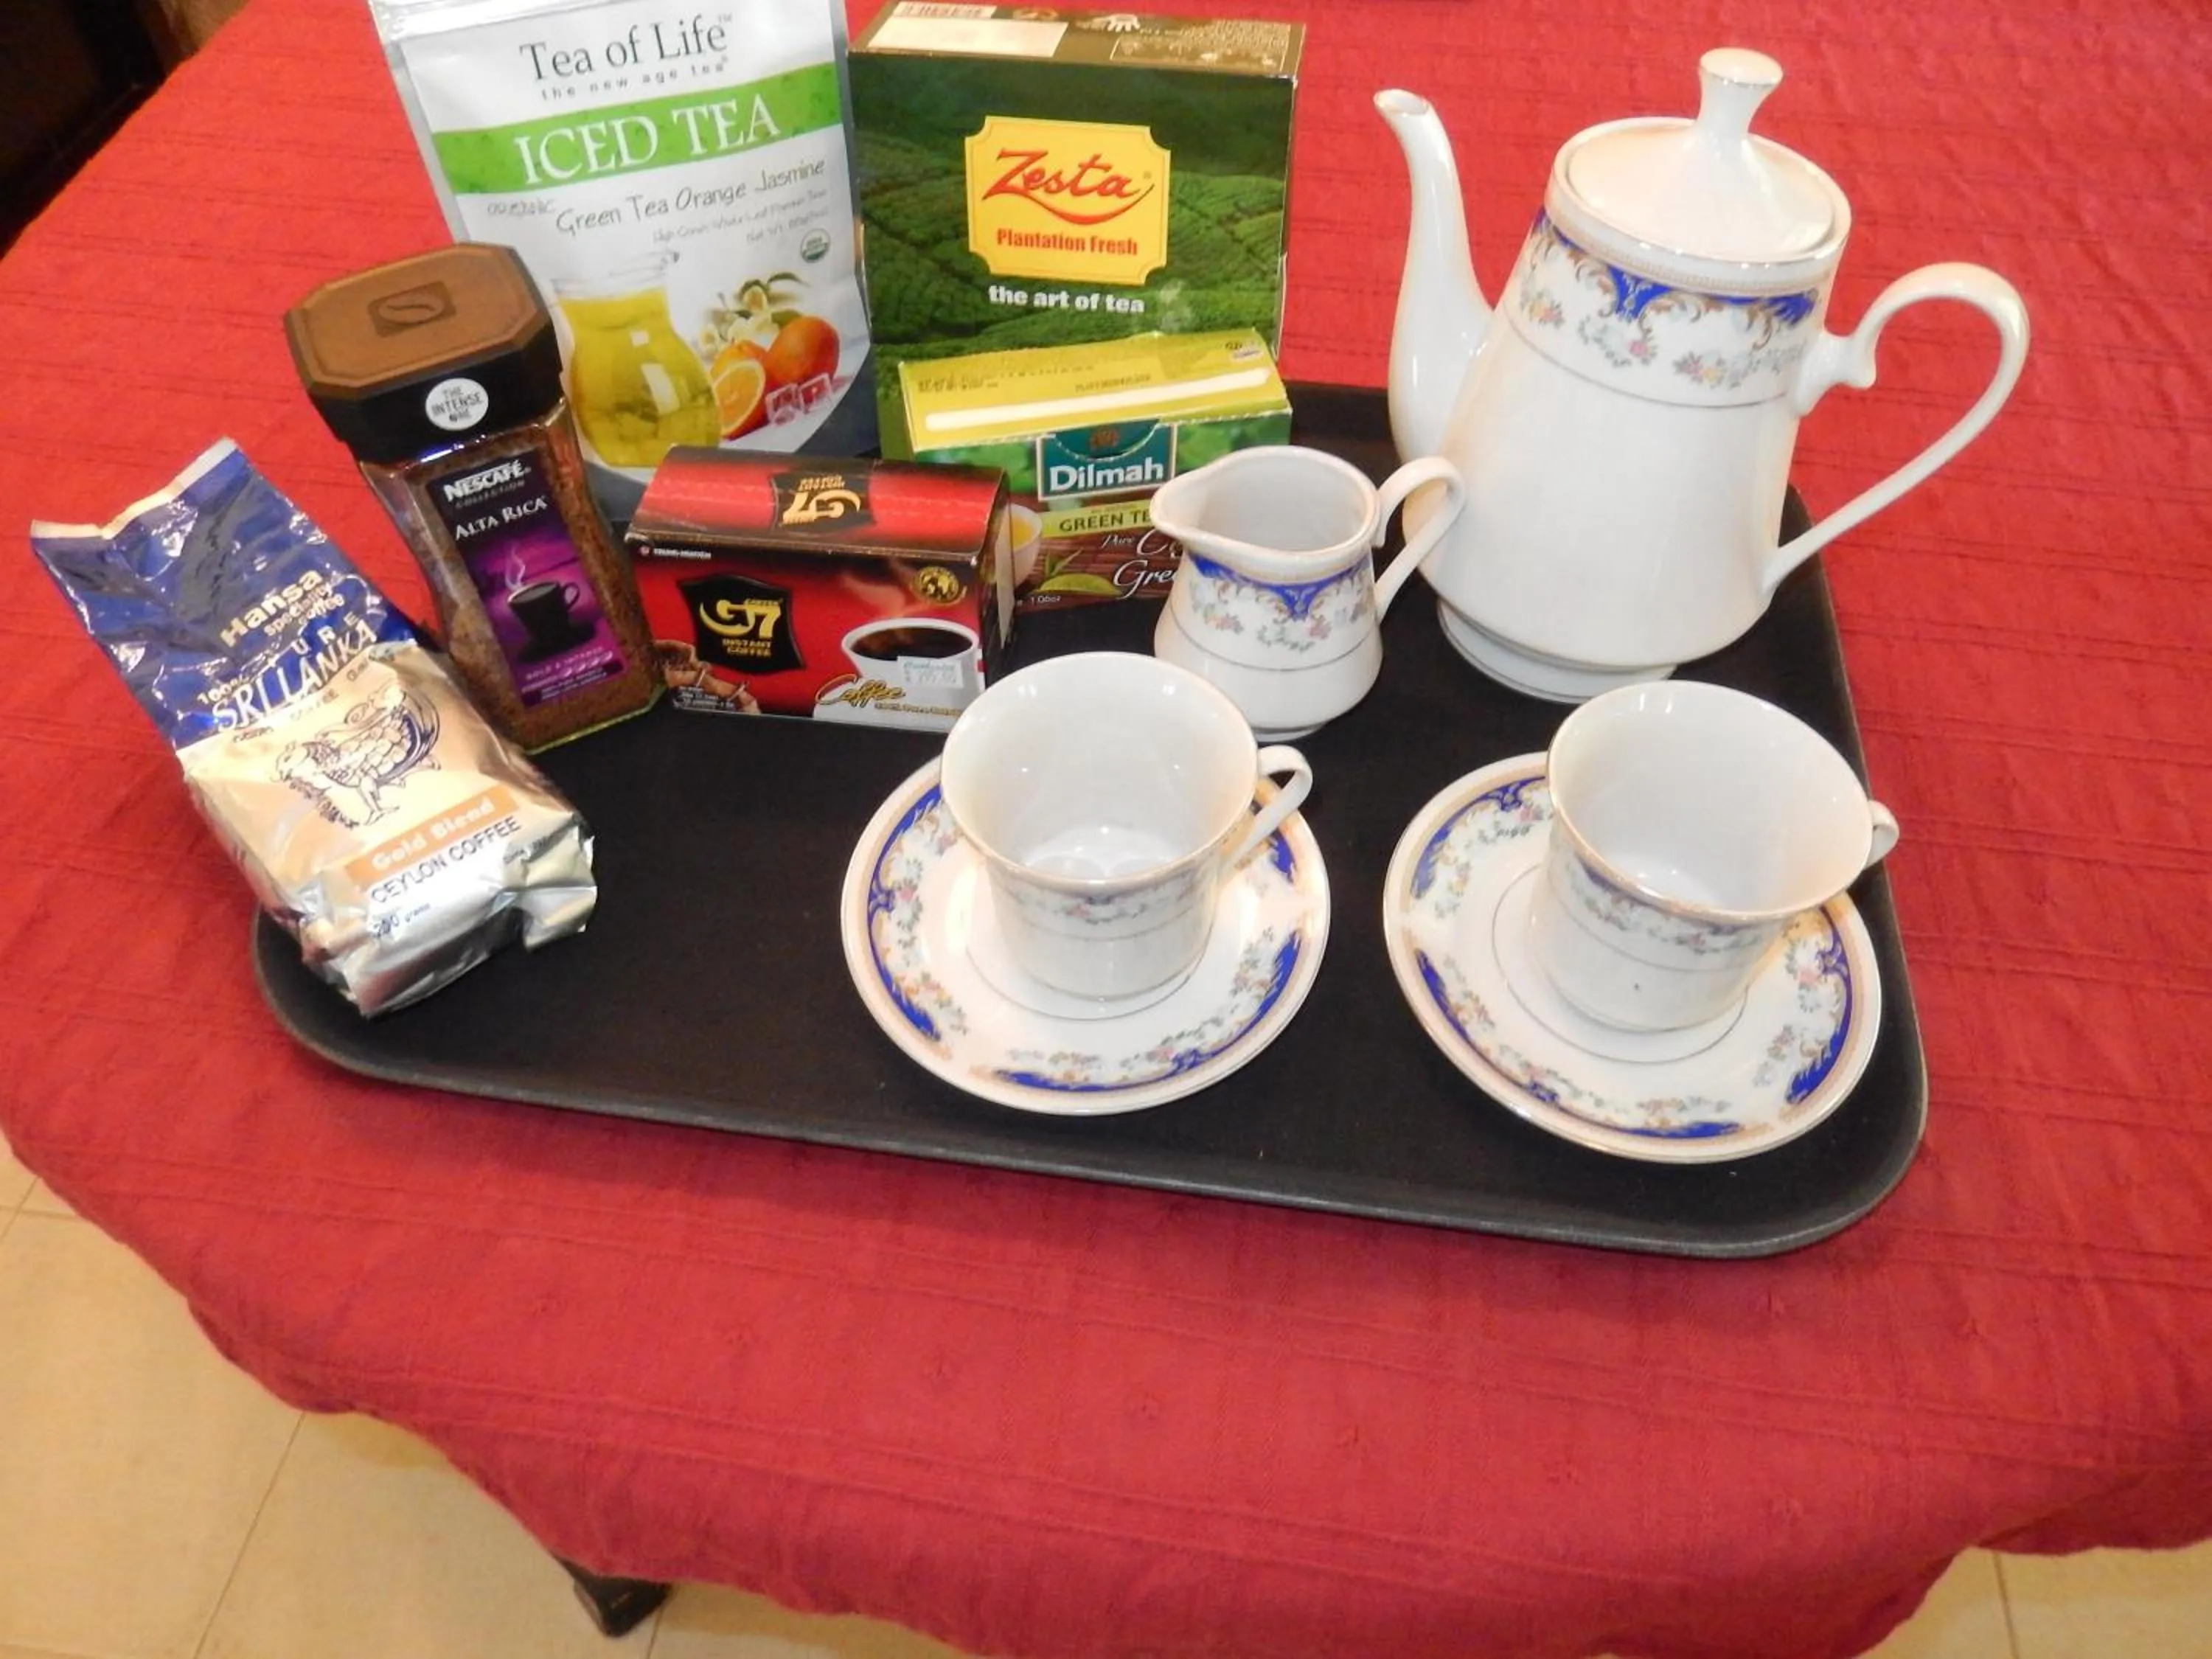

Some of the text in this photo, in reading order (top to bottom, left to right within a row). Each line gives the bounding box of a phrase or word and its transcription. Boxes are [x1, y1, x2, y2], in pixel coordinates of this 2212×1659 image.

[519, 42, 596, 80] Tea
[605, 24, 641, 67] of
[650, 14, 728, 60] Life
[541, 86, 575, 101] the
[590, 77, 628, 93] new
[642, 67, 678, 83] age
[514, 93, 781, 185] ICED TEA
[982, 147, 1144, 201] Zesta
[556, 156, 827, 237] Green Tea Orange Jasmine
[997, 229, 1138, 255] Plantation Fresh
[989, 285, 1144, 313] the art of tea
[444, 459, 525, 502] NESCAFÉ
[1049, 457, 1164, 493] Dilmah
[454, 496, 548, 540] ALTA RICA
[1059, 511, 1124, 532] GREEN
[1128, 509, 1152, 524] TE
[220, 570, 323, 647] Hansa
[299, 593, 345, 626] coffee
[699, 599, 782, 639] G7
[723, 639, 772, 649] INSTANT
[212, 673, 271, 732] SRI
[276, 619, 378, 701] LANKA
[372, 796, 495, 871] Gold Blend
[371, 854, 448, 904] CEYLON
[448, 815, 521, 861] COFFEE
